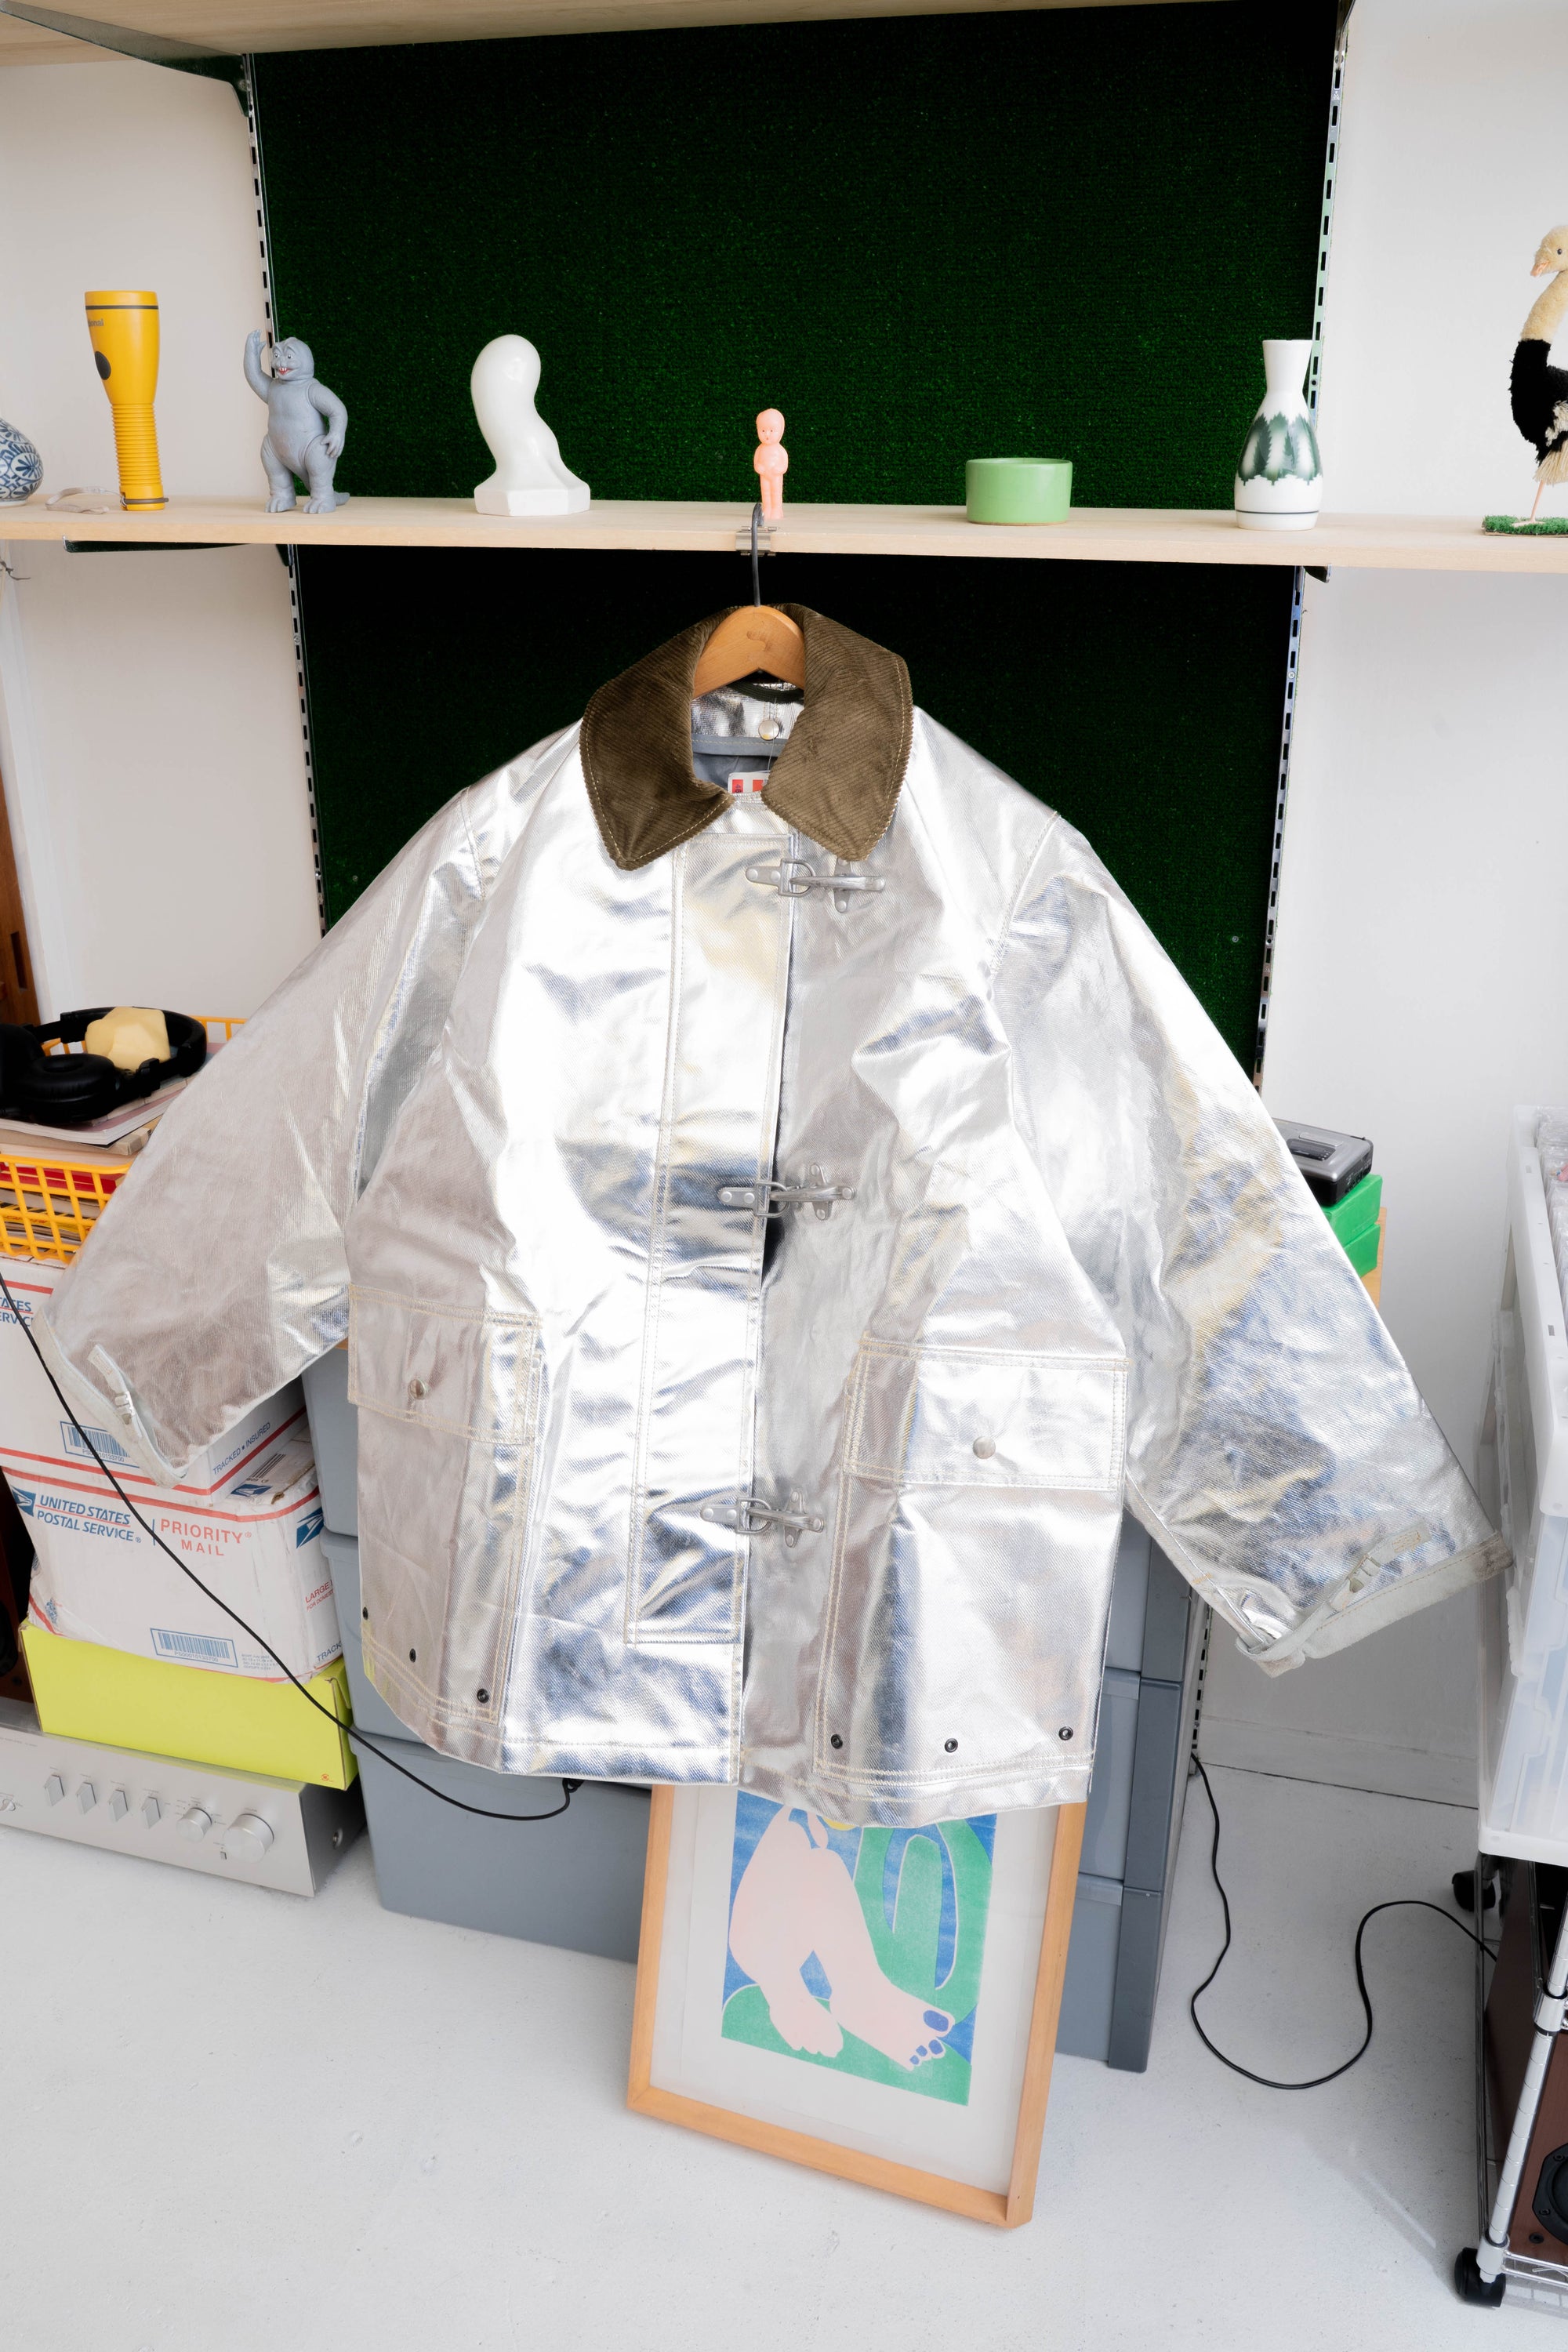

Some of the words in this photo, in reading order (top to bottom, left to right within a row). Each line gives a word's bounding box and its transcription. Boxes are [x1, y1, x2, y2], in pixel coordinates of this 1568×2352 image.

[212, 1447, 241, 1475] TRACKED
[245, 1422, 270, 1448] INSURED
[37, 1510, 80, 1530] POSTAL
[40, 1495, 85, 1515] UNITED
[86, 1506, 131, 1525] STATES
[181, 1539, 224, 1556] MAIL
[305, 1581, 330, 1603] LARGE
